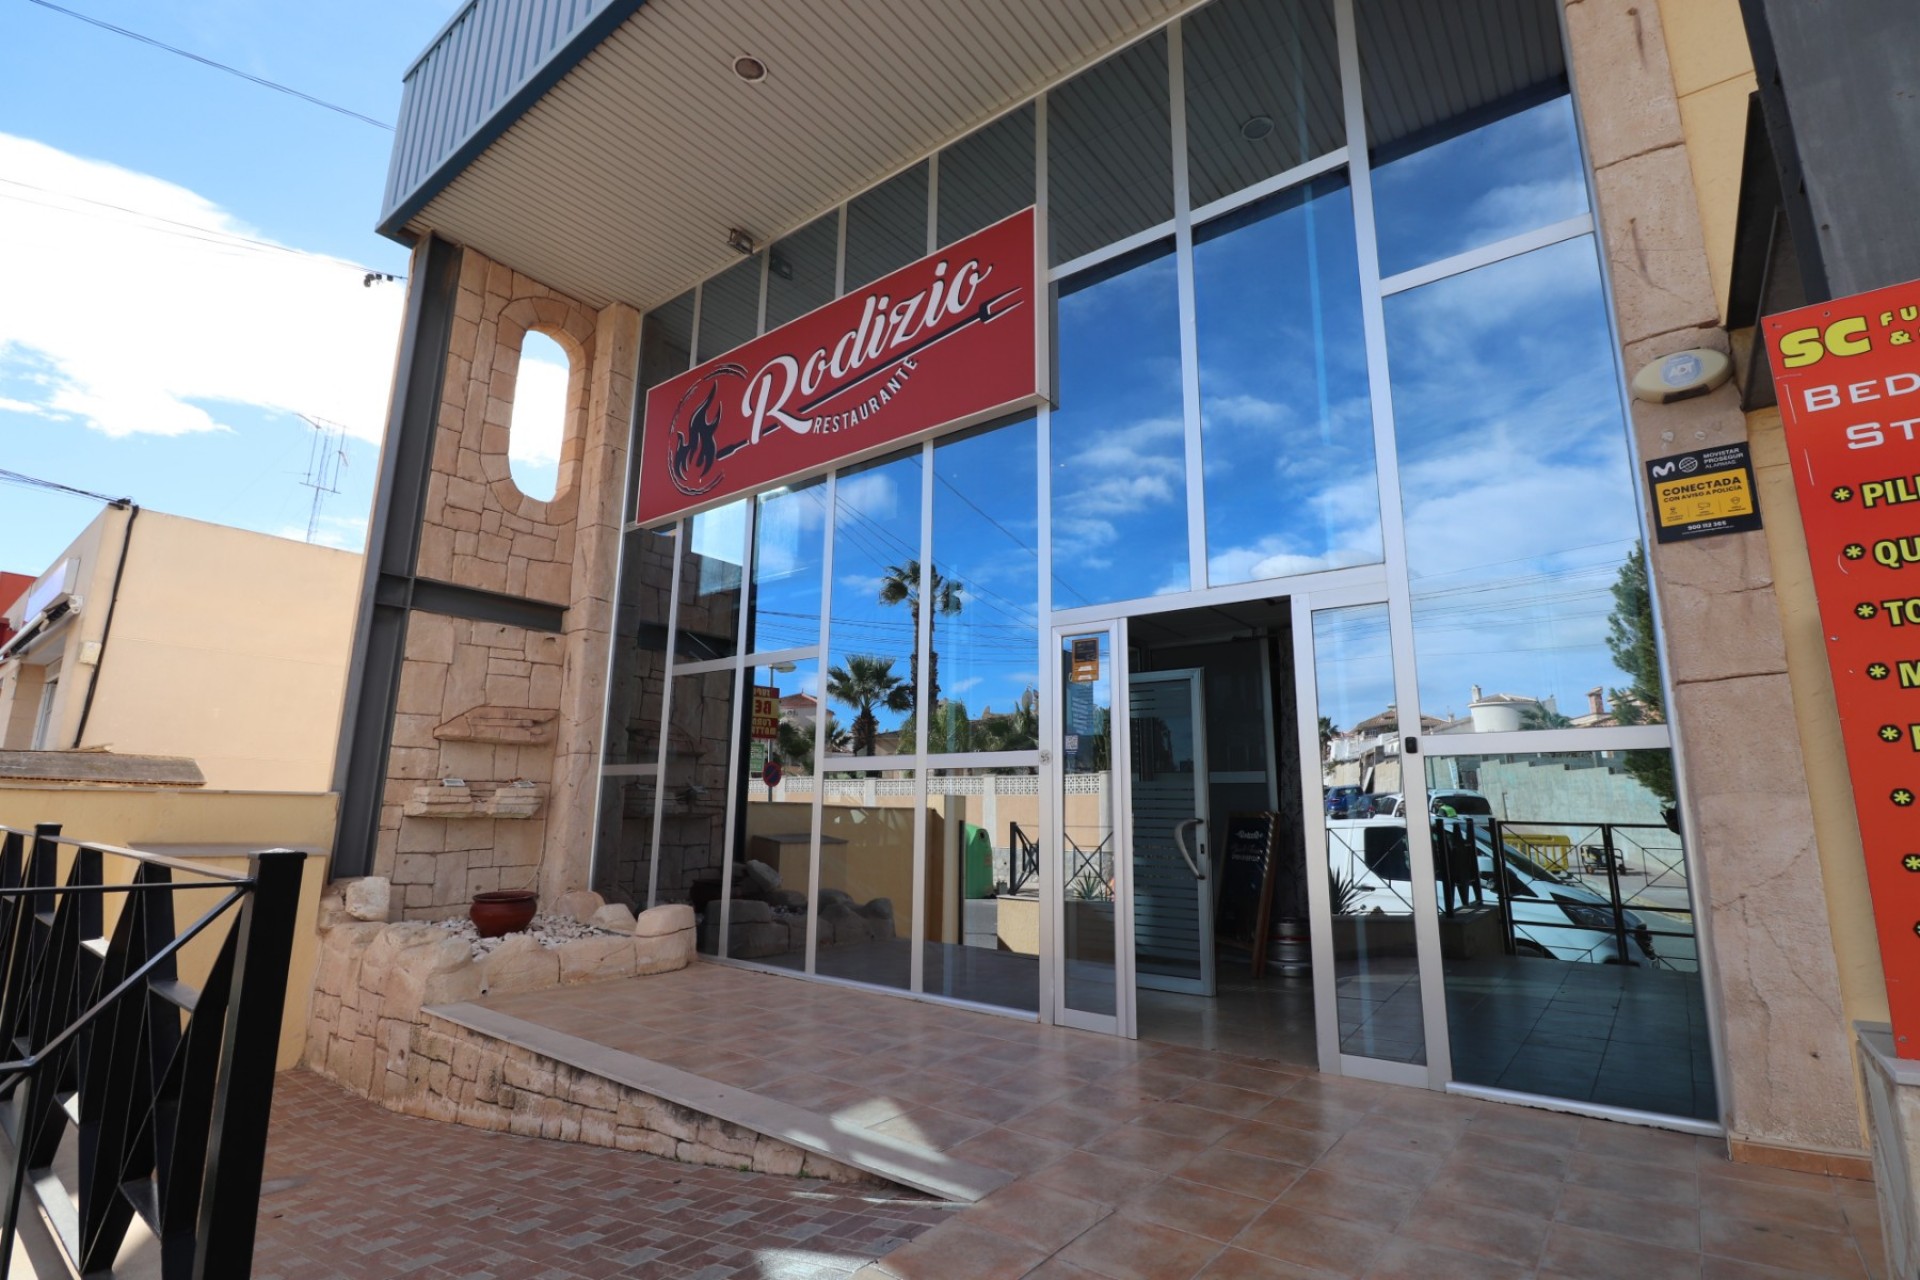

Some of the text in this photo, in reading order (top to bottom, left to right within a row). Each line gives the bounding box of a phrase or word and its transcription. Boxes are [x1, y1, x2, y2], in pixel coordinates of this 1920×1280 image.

[741, 259, 993, 445] Rodizio
[1780, 316, 1872, 369] SC
[813, 357, 918, 435] RESTAURANTE
[1803, 373, 1920, 413] BED
[1845, 417, 1920, 450] ST
[1702, 448, 1740, 458] MOVISTAR
[1703, 453, 1744, 464] PROSEGUR
[1662, 476, 1741, 497] CONECTADA
[1663, 495, 1680, 503] CON
[1681, 491, 1705, 500] AVISO
